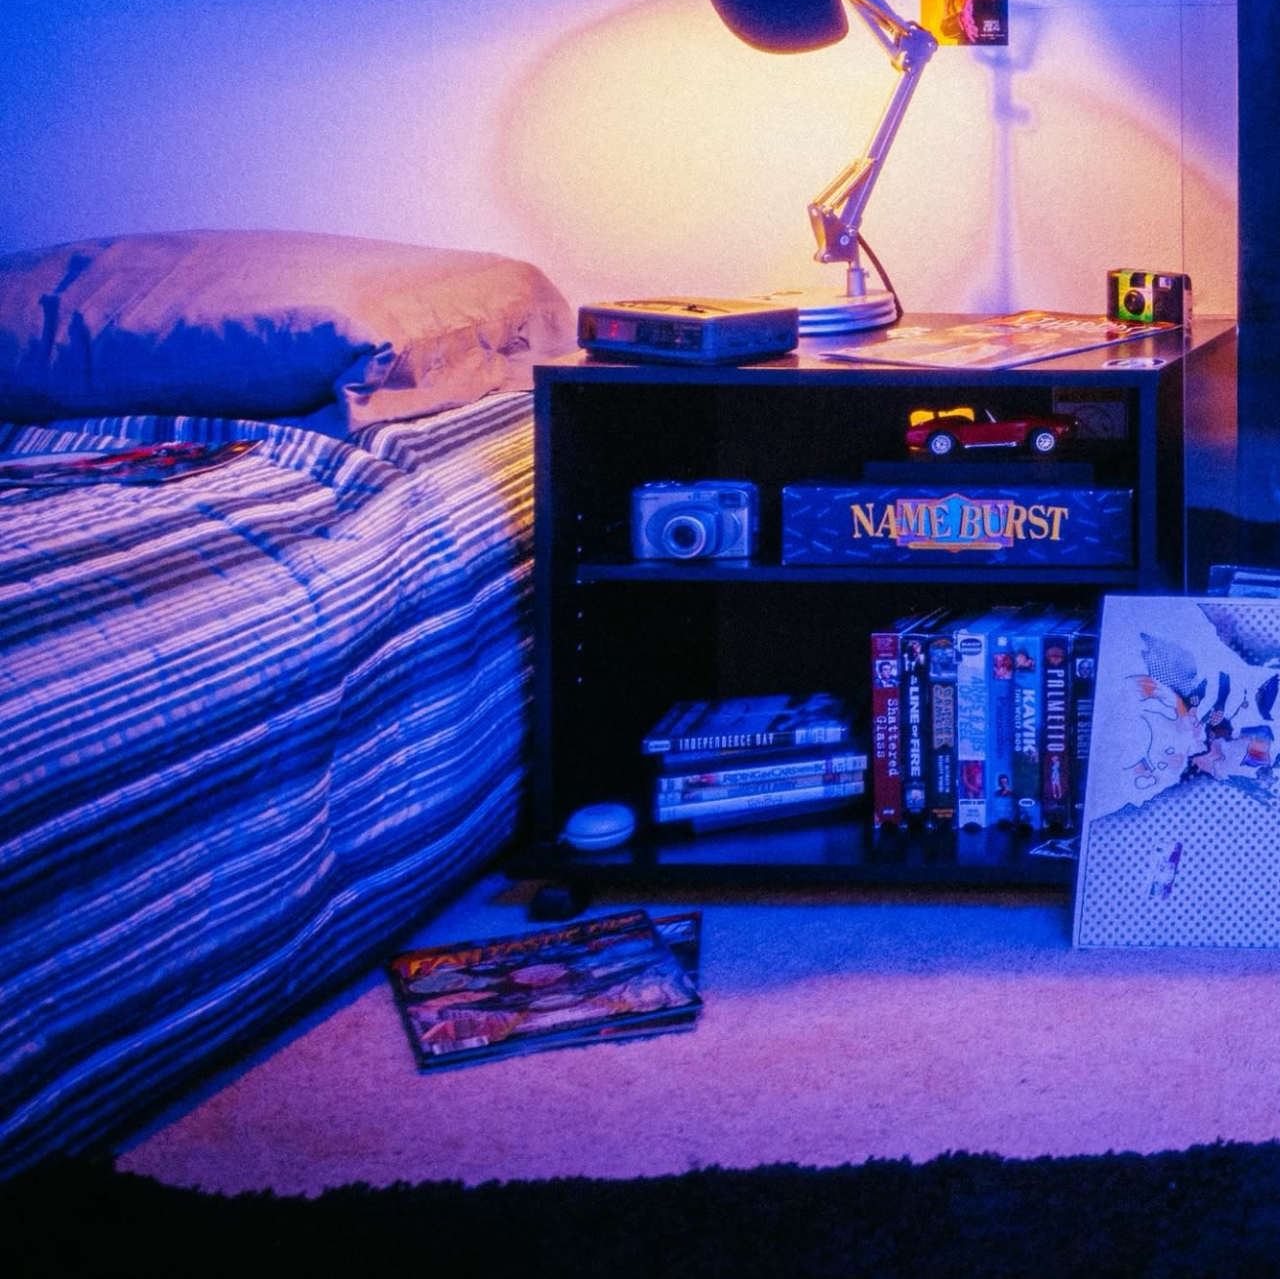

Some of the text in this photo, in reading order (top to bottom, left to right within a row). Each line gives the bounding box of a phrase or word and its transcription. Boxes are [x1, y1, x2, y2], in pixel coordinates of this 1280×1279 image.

[850, 503, 1069, 541] NAME BURST
[679, 732, 775, 752] INDEPENDENCE DAY
[875, 715, 887, 759] Glass
[887, 698, 900, 777] Shattered
[908, 686, 920, 777] LINE FIRE
[1022, 688, 1036, 754] KAVIK
[1047, 669, 1066, 753] PALMETTO
